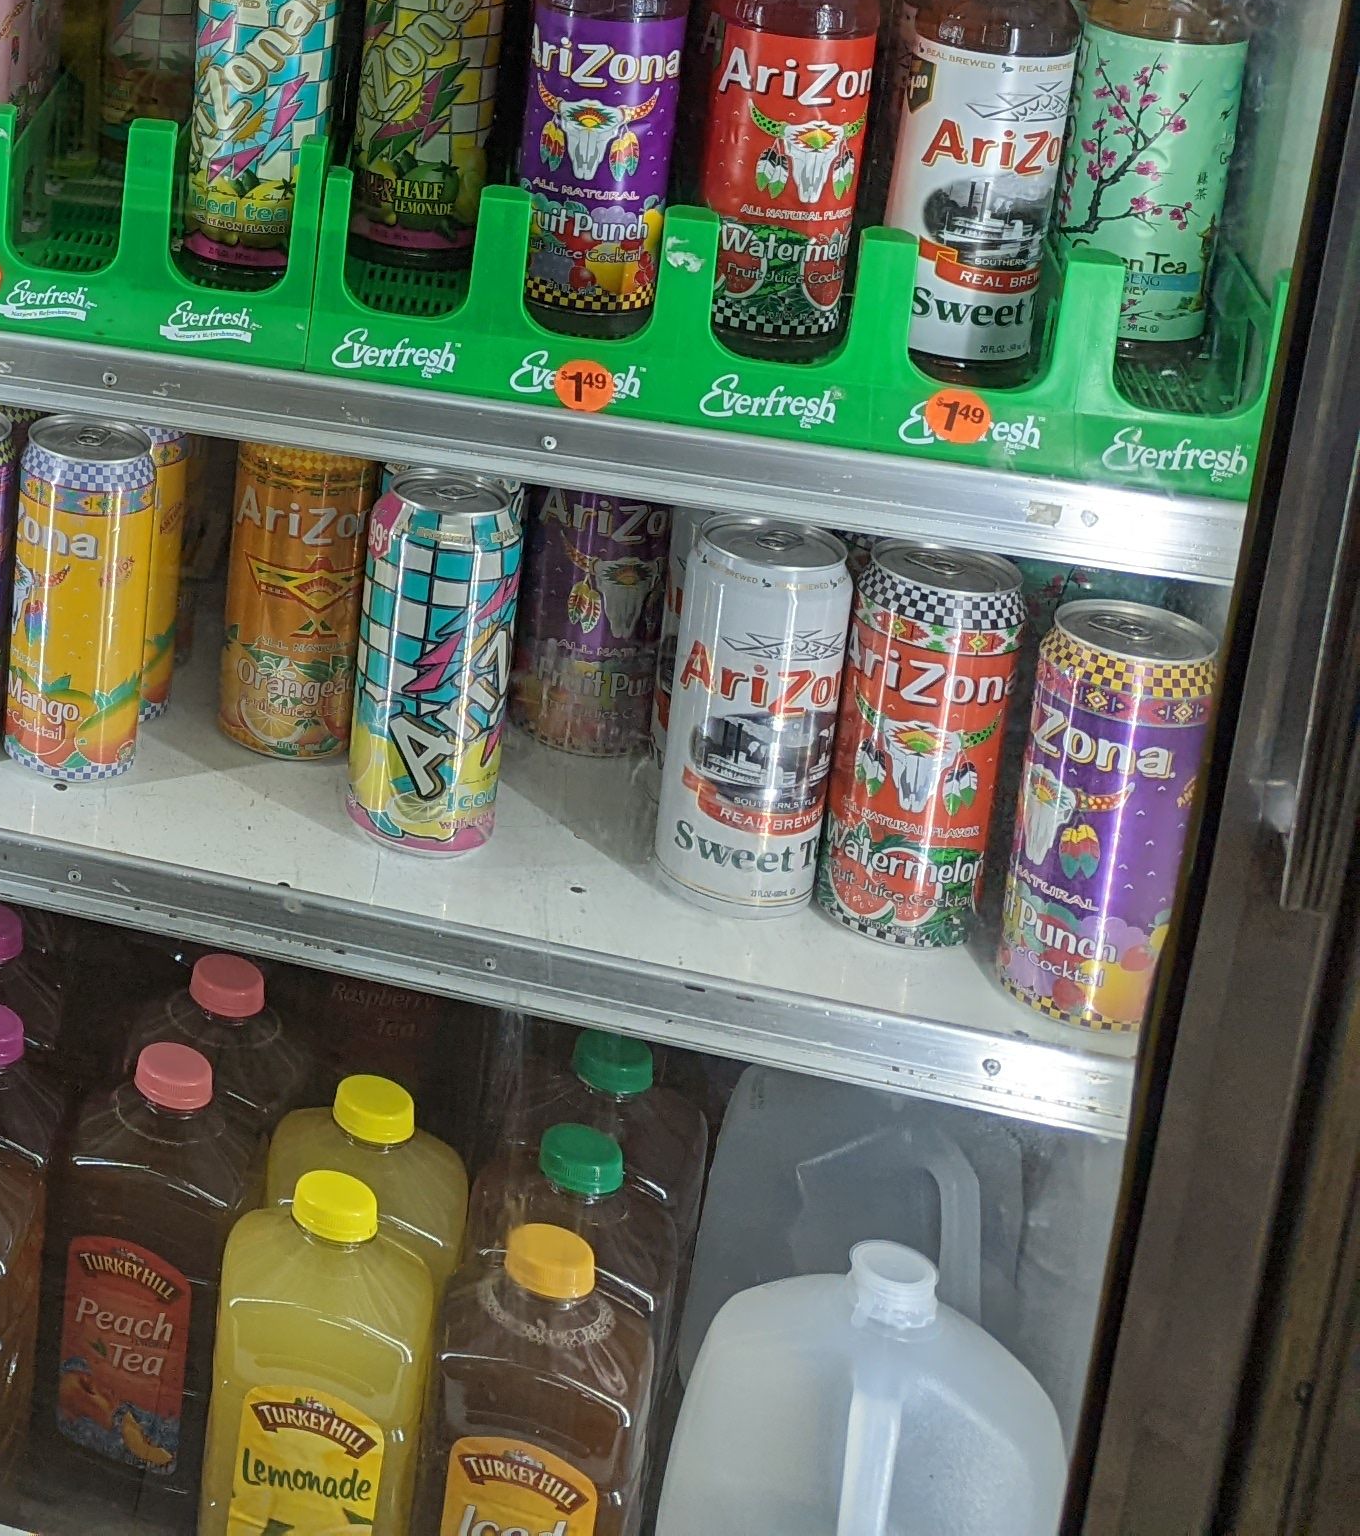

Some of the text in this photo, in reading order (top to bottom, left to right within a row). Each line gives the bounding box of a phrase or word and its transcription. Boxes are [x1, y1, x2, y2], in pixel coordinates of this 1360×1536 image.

[394, 198, 453, 217] LEMONADE
[395, 180, 445, 202] HALF
[572, 213, 650, 242] Punch
[763, 206, 821, 222] NATURAL
[1146, 252, 1188, 274] Tea
[6, 279, 84, 307] Everfresh
[959, 271, 1005, 290] REAL
[167, 301, 252, 329] Everfresh
[911, 285, 1023, 327] Sweet
[331, 327, 456, 373] Everfresh
[699, 374, 837, 421] Everfresh
[1102, 427, 1248, 474] Everfresh
[8, 675, 80, 722] Mango
[718, 806, 762, 829] REAL
[673, 818, 796, 873] Sweet
[1015, 905, 1119, 964] Punch
[1033, 956, 1106, 988] Cocktail
[75, 1297, 175, 1343] Peach
[108, 1341, 166, 1377] Tea
[241, 1447, 373, 1503] Lemonade
